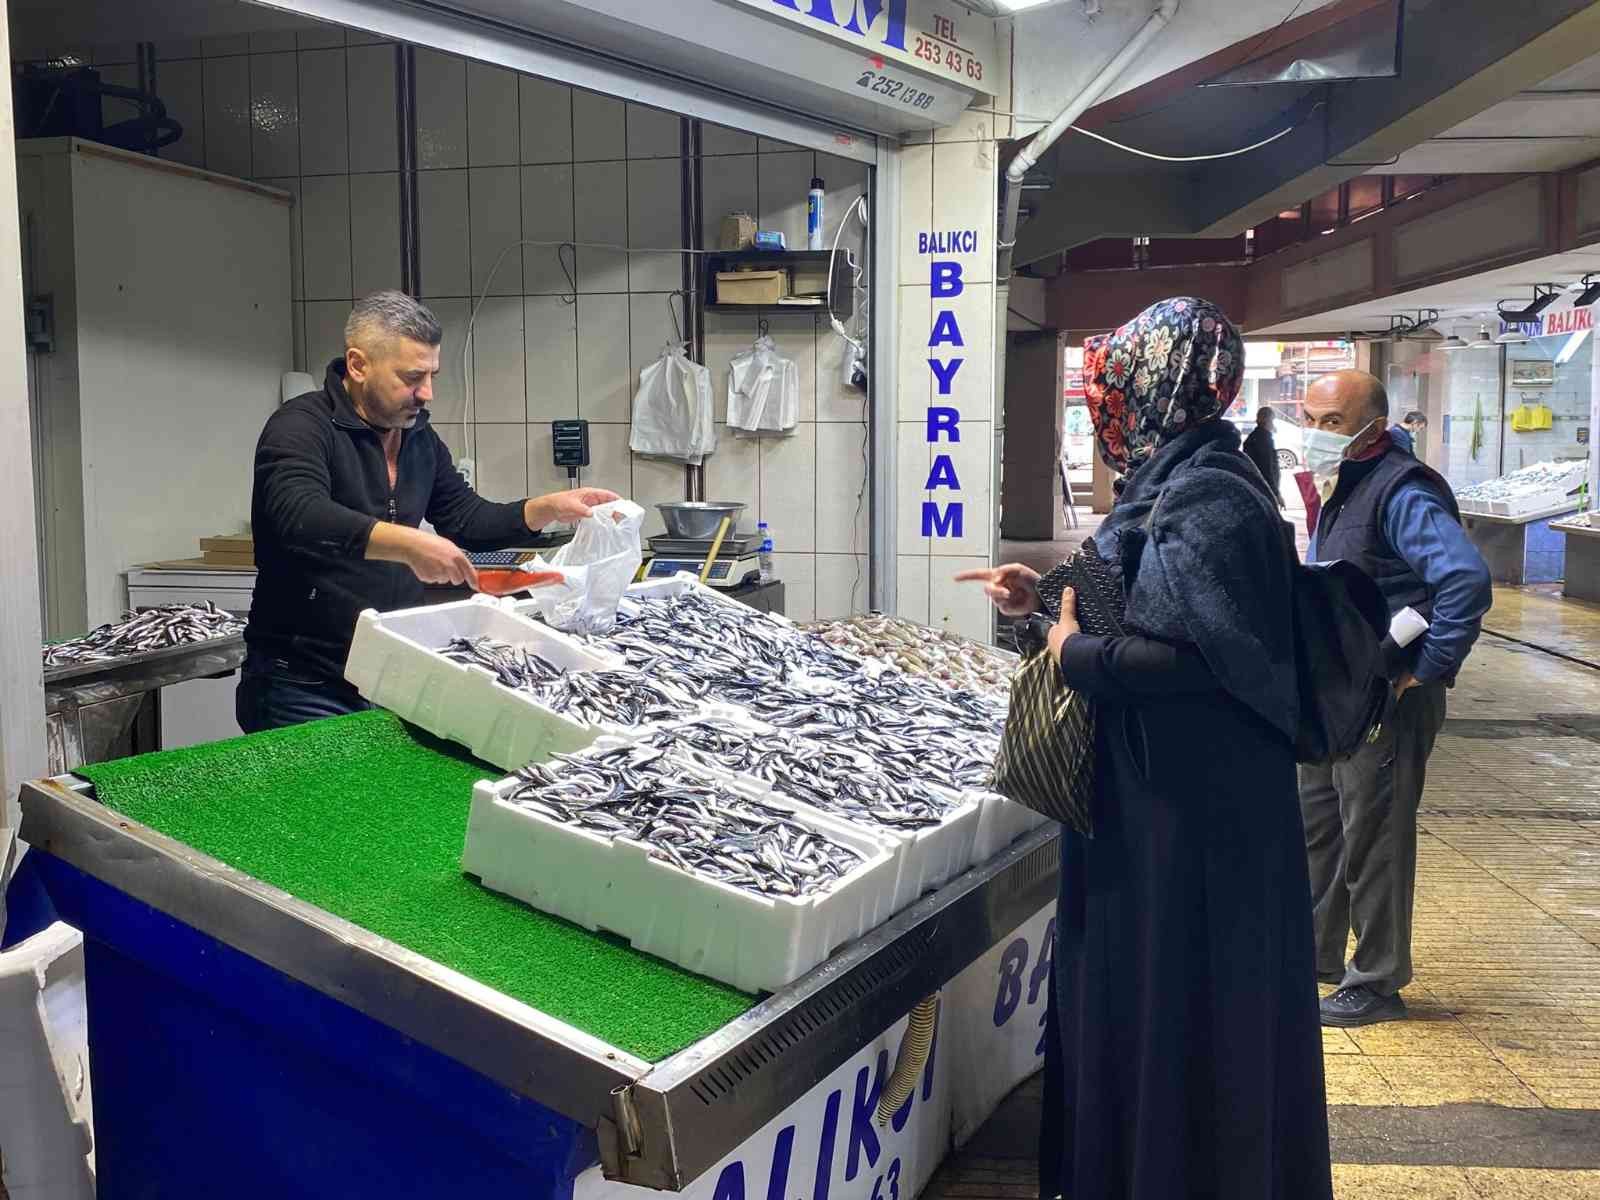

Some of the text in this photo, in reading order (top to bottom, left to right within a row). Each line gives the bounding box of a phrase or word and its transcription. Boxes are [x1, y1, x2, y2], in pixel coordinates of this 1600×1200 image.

[933, 14, 957, 42] TEL
[915, 37, 983, 81] 253 43 63
[918, 230, 977, 254] BALIKCI
[920, 261, 964, 538] BAYRAM
